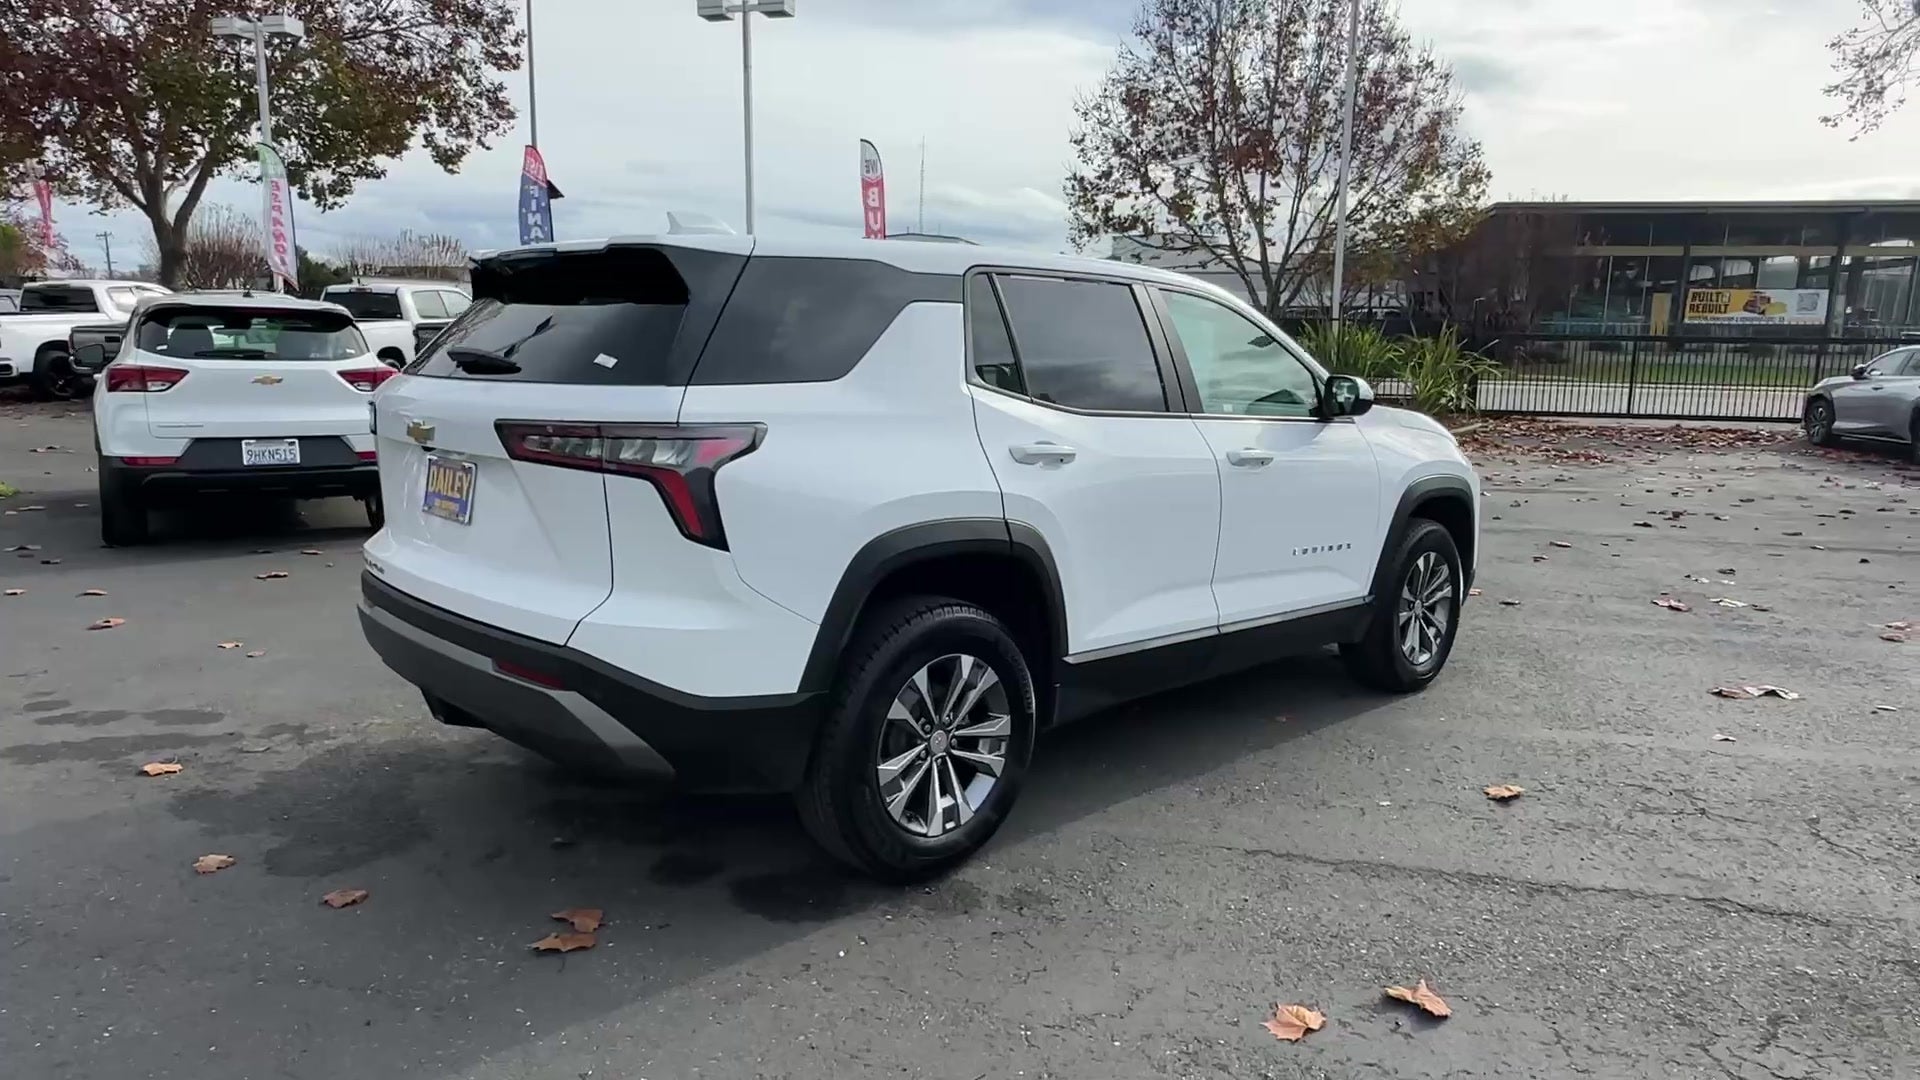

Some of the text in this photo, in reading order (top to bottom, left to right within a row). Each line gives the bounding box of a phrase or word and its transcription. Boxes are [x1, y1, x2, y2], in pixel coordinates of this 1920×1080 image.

[1690, 291, 1722, 303] BUILT
[1688, 303, 1729, 315] REBUILT
[246, 449, 296, 463] 9HKN515
[428, 465, 471, 499] DAILEY
